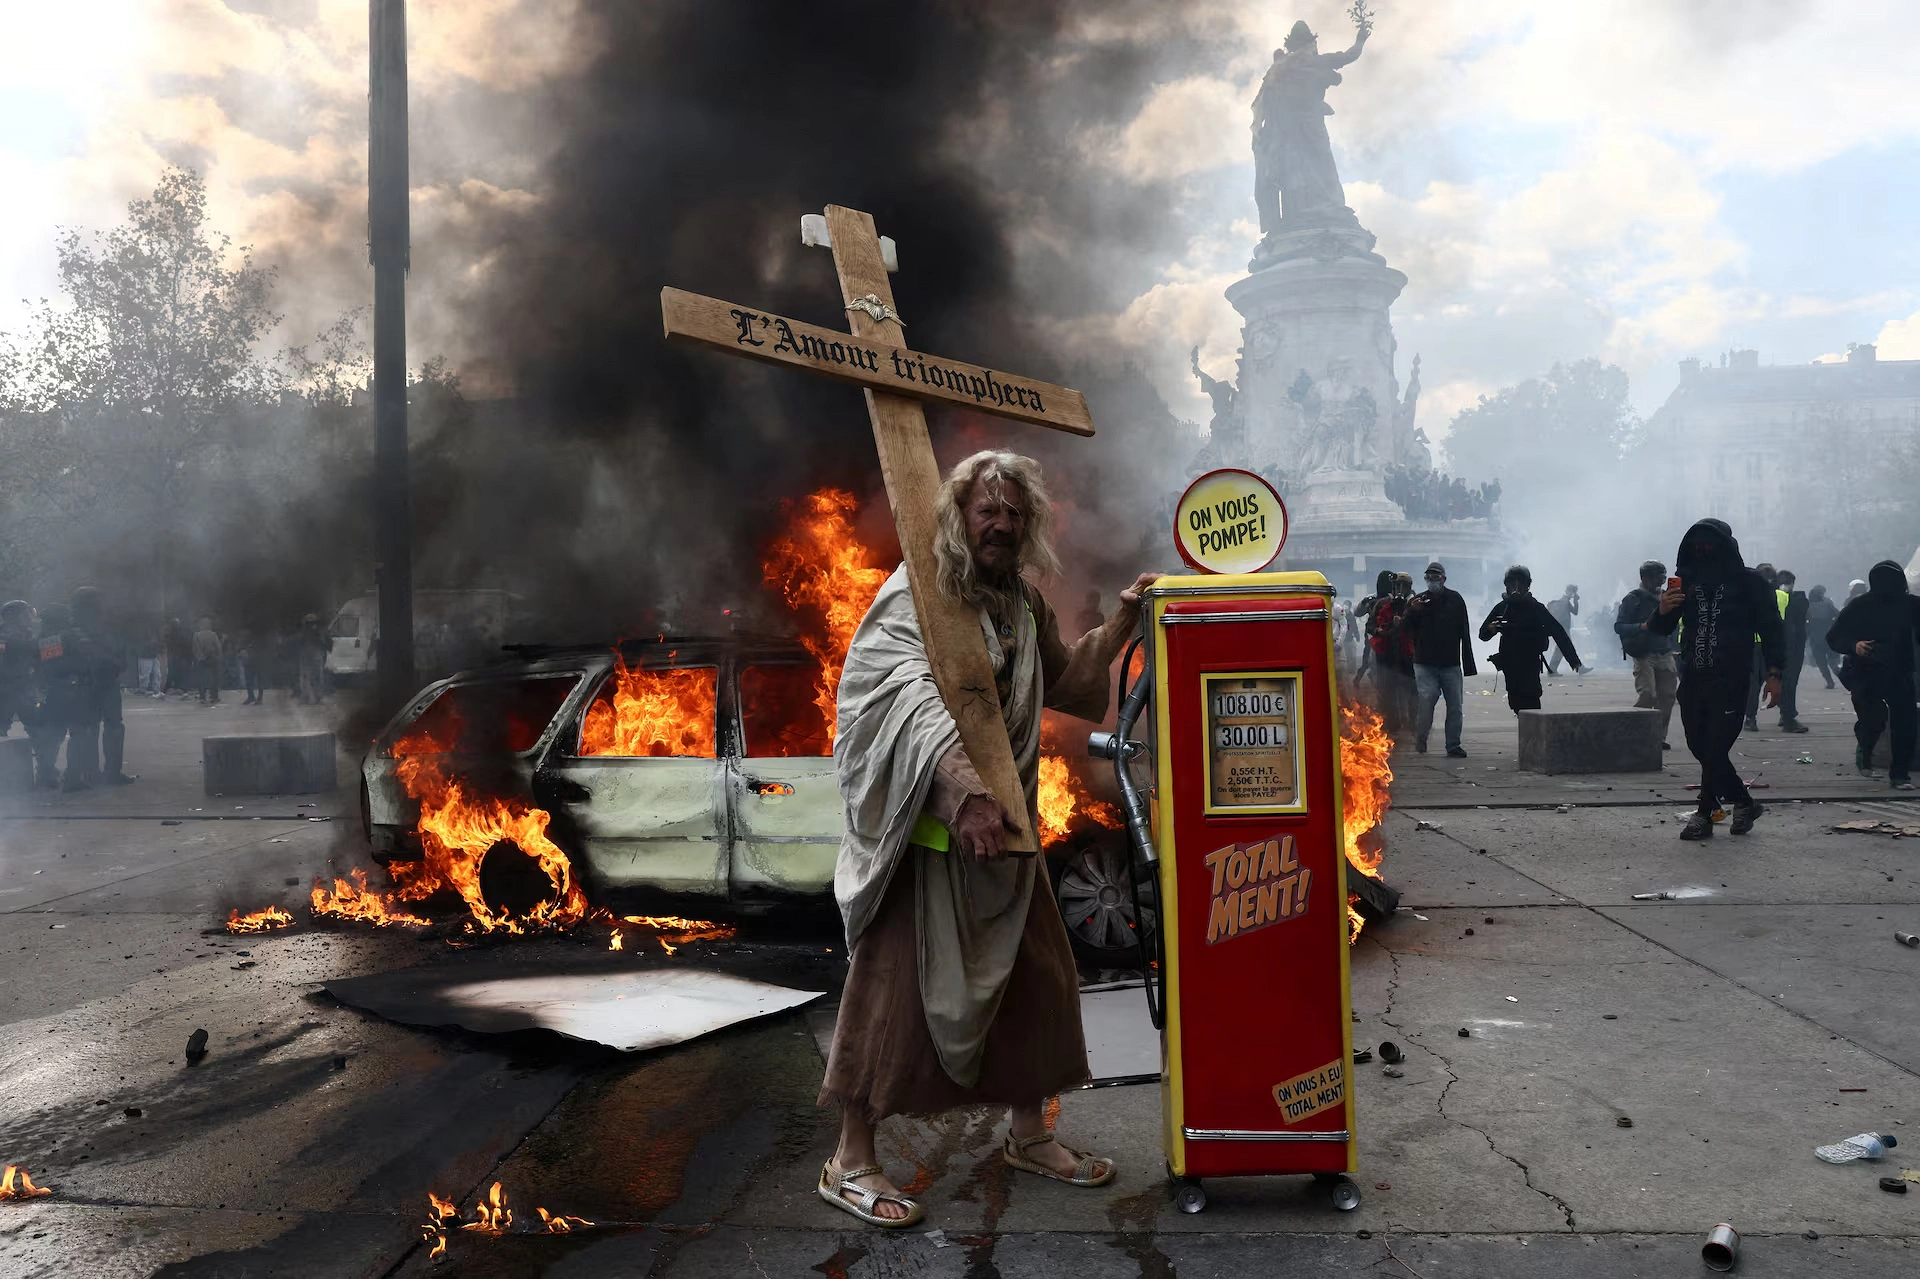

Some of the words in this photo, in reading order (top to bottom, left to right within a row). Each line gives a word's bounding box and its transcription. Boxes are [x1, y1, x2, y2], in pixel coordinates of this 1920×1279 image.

[730, 309, 880, 373] L'Amour
[890, 349, 1047, 414] triomphera
[1189, 507, 1212, 531] ON
[1215, 493, 1259, 523] VOUS
[1198, 515, 1266, 556] POMPE!
[1222, 726, 1268, 746] 30,00
[1273, 726, 1282, 745] L
[1227, 777, 1253, 786] 2,50€
[1255, 776, 1282, 785] T.T.C.
[1231, 767, 1255, 776] 0,55€
[1258, 766, 1277, 775] H.T.
[1205, 835, 1298, 896] TOTAL
[1207, 869, 1311, 943] MENT!
[1278, 1085, 1292, 1102] ON
[1293, 1076, 1318, 1096] VOUS
[1320, 1072, 1327, 1087] A
[1285, 1096, 1316, 1118] TOTAL
